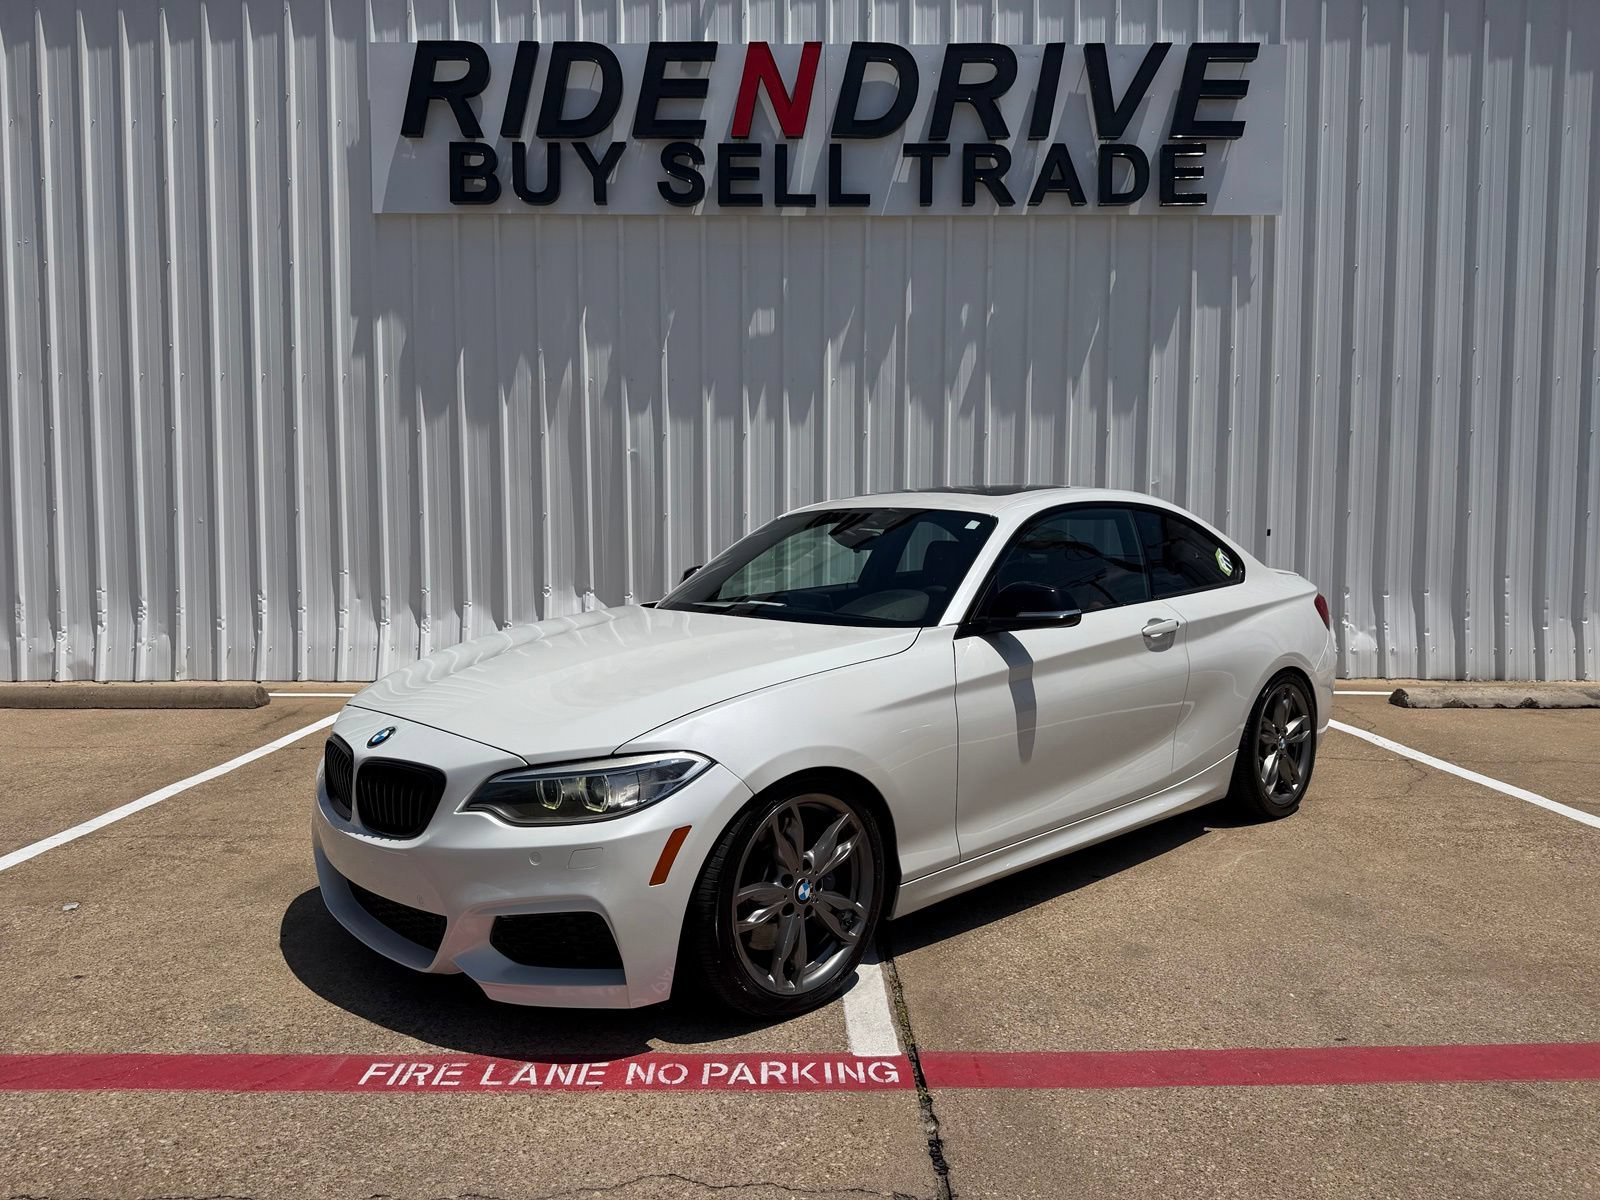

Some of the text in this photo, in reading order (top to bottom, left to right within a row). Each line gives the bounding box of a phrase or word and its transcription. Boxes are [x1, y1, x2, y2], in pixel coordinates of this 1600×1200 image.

[448, 141, 1208, 208] BUY SELL TRADE
[357, 1061, 900, 1086] FIRE LANE NO PARKING
